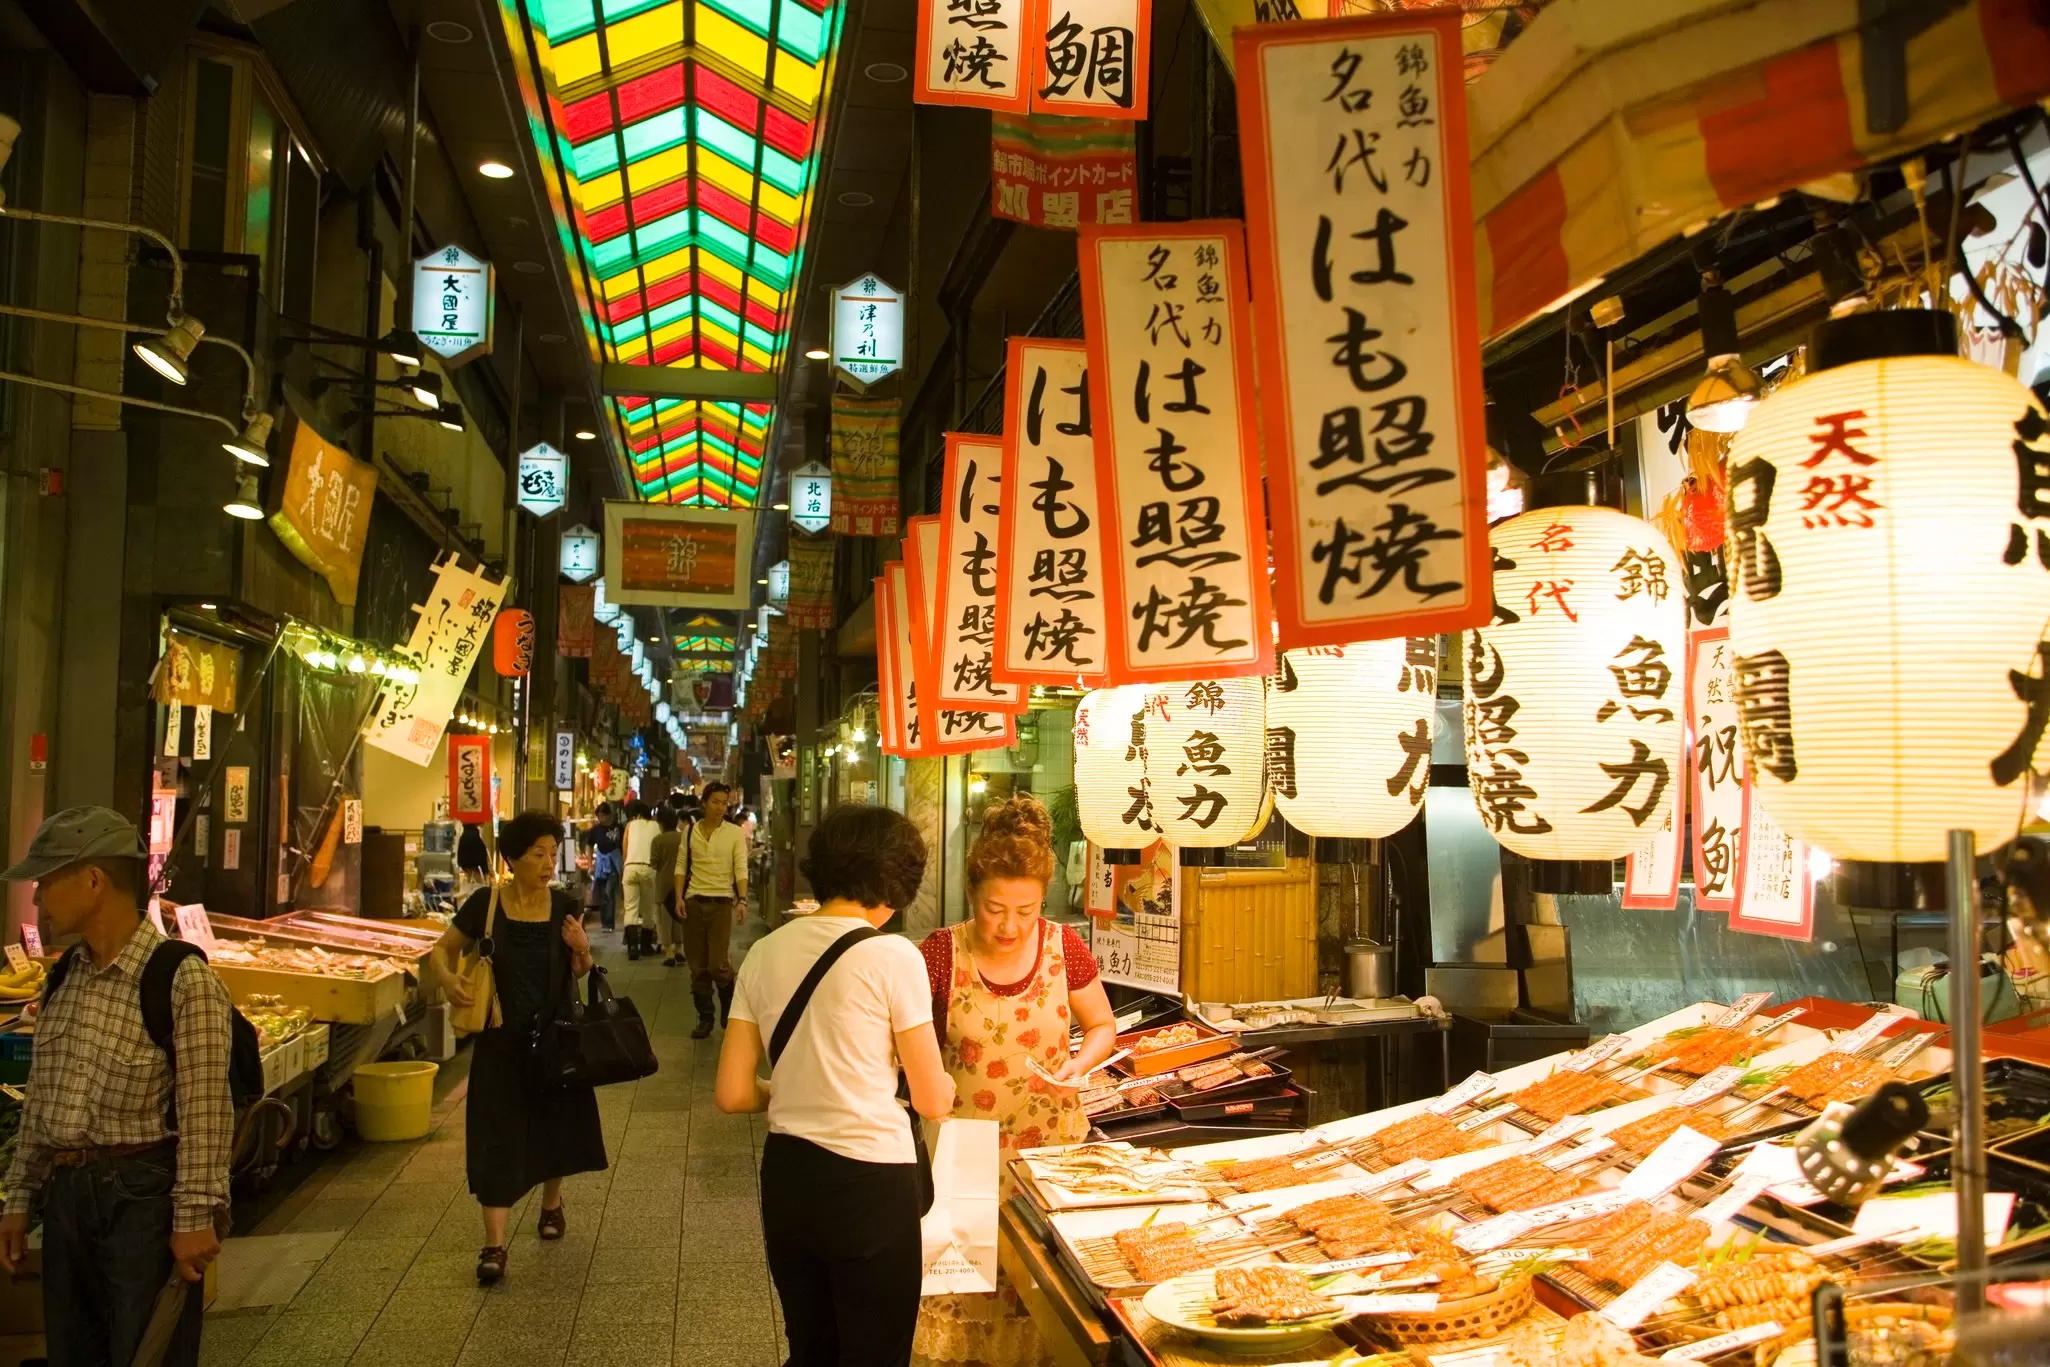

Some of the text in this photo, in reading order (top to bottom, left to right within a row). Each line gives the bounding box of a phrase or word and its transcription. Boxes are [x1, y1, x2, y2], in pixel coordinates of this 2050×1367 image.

[1038, 10, 1135, 109] 鯛
[1394, 44, 1436, 189] 錦魚力
[993, 149, 1133, 188] 錦市場ポイントカード
[996, 179, 1133, 228] 加盟店
[442, 275, 462, 331] 大國屋
[862, 278, 877, 296] 錦
[1193, 244, 1226, 347] 錦魚力
[857, 303, 877, 357] 津乃利
[848, 363, 889, 374] 特選鮮魚
[807, 481, 822, 513] 北治
[1797, 409, 1886, 530] 天然
[1525, 523, 1578, 623] 名代
[1578, 545, 1675, 828] 錦魚力
[1706, 645, 1725, 705] 天然
[1176, 681, 1233, 829] 錦魚力
